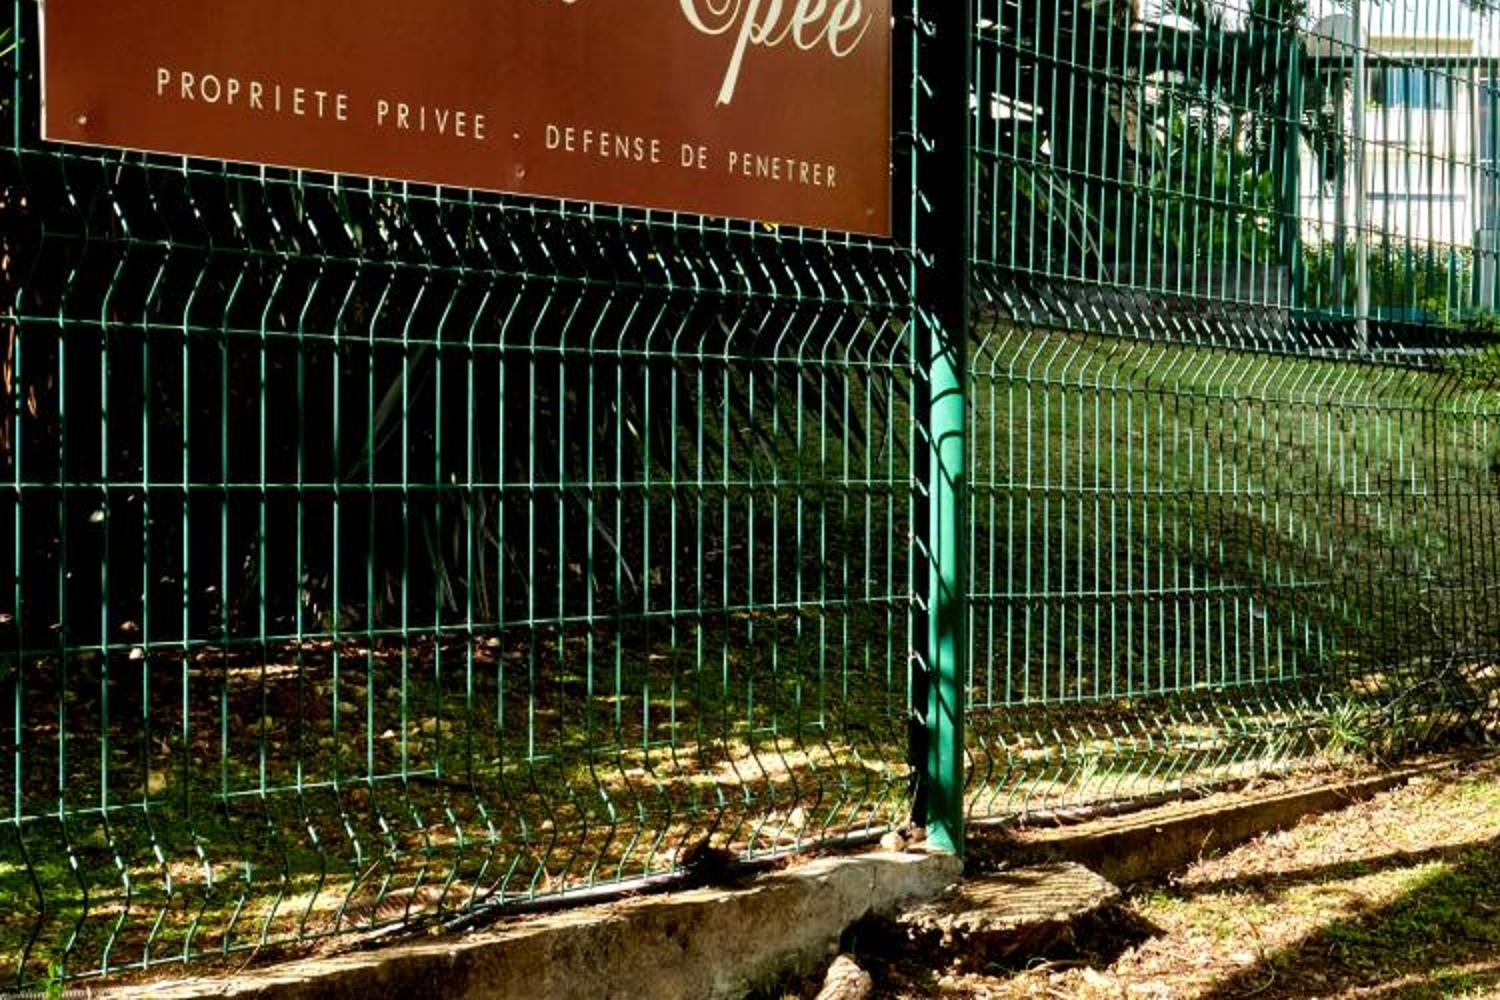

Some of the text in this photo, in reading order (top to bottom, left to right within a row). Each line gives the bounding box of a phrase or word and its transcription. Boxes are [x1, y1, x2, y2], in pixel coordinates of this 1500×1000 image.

[157, 67, 837, 188] PROPRIETE PRIVEE DEFENSE DE PENETRER
